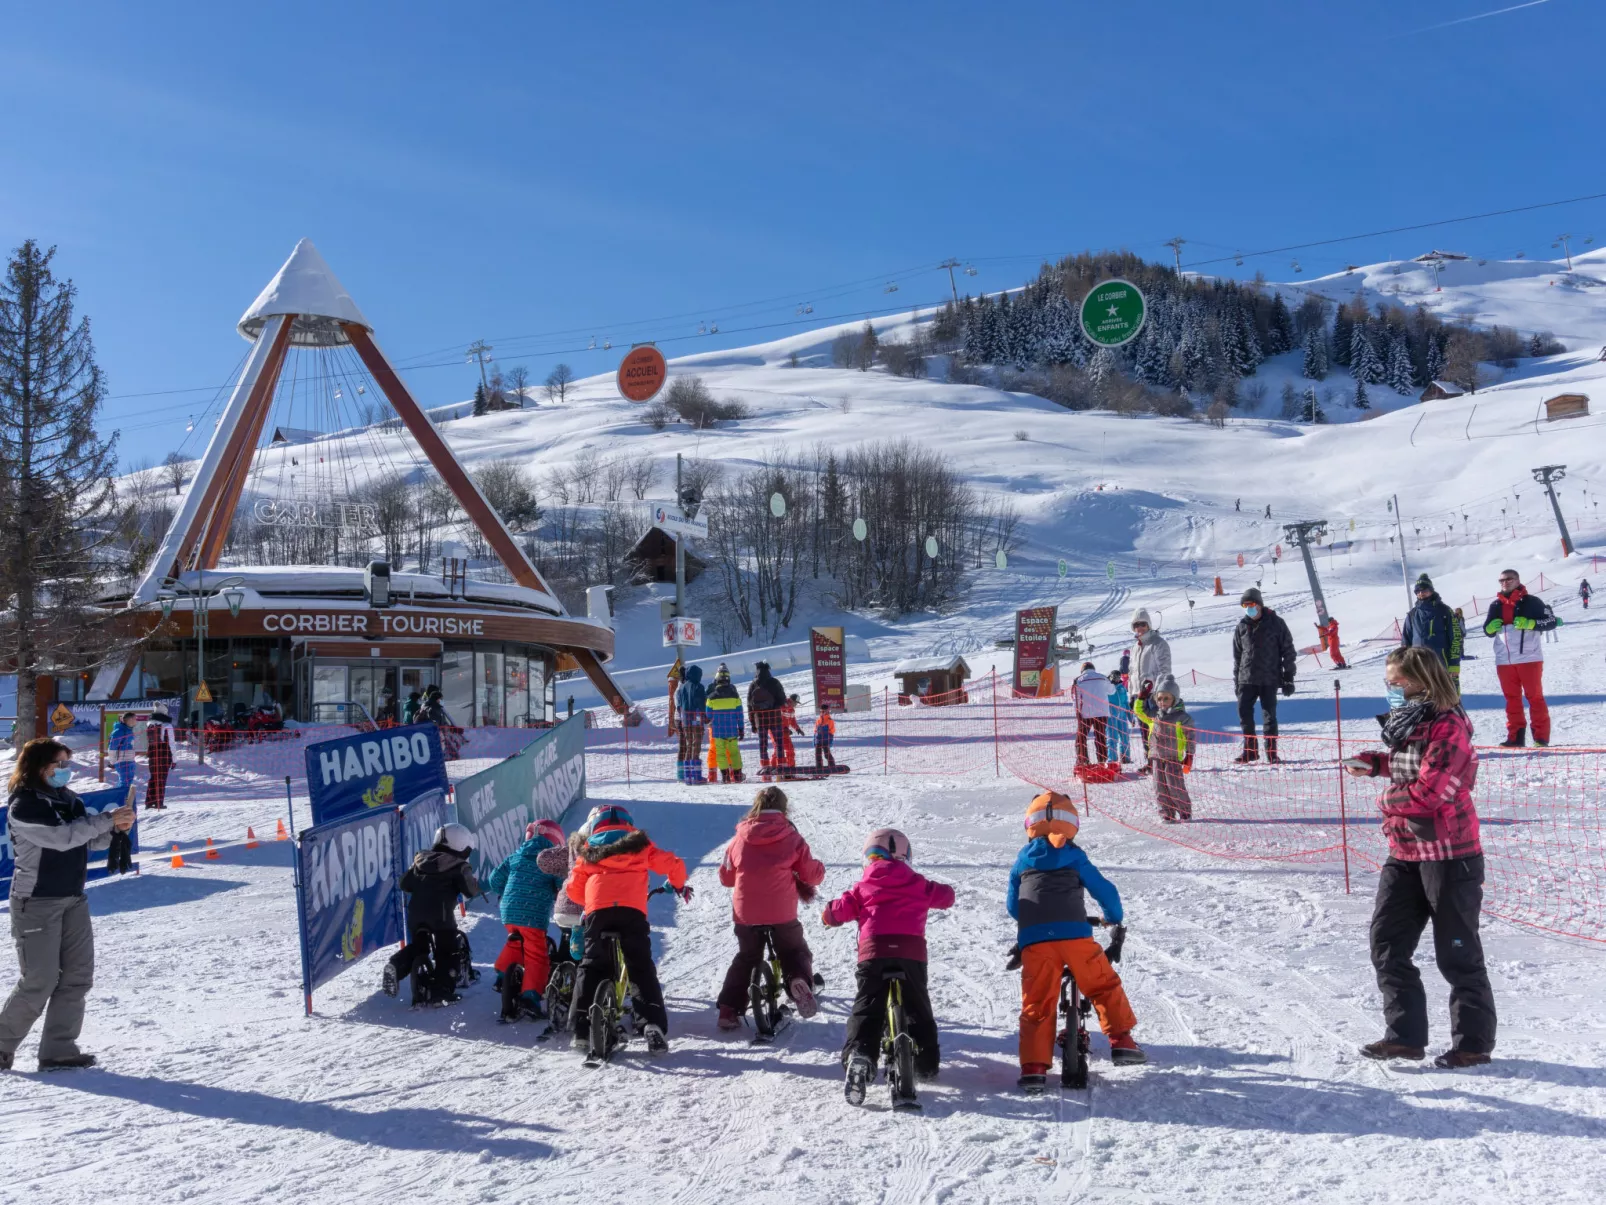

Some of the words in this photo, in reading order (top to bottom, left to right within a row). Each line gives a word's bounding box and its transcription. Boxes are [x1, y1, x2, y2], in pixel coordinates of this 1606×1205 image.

[1097, 294, 1104, 302] LE
[1105, 291, 1127, 301] CORBIER
[1098, 322, 1129, 332] ENFANTS
[626, 365, 659, 378] ACCUEIL
[263, 614, 368, 632] CORBIER
[380, 615, 484, 636] TOURISME
[1021, 617, 1048, 626] Espace
[1020, 634, 1047, 642] Etoiles
[815, 645, 839, 653] Espace
[130, 697, 181, 709] MOTOEIGE
[320, 732, 431, 786] HARIBO
[311, 821, 393, 913] HARIBO
